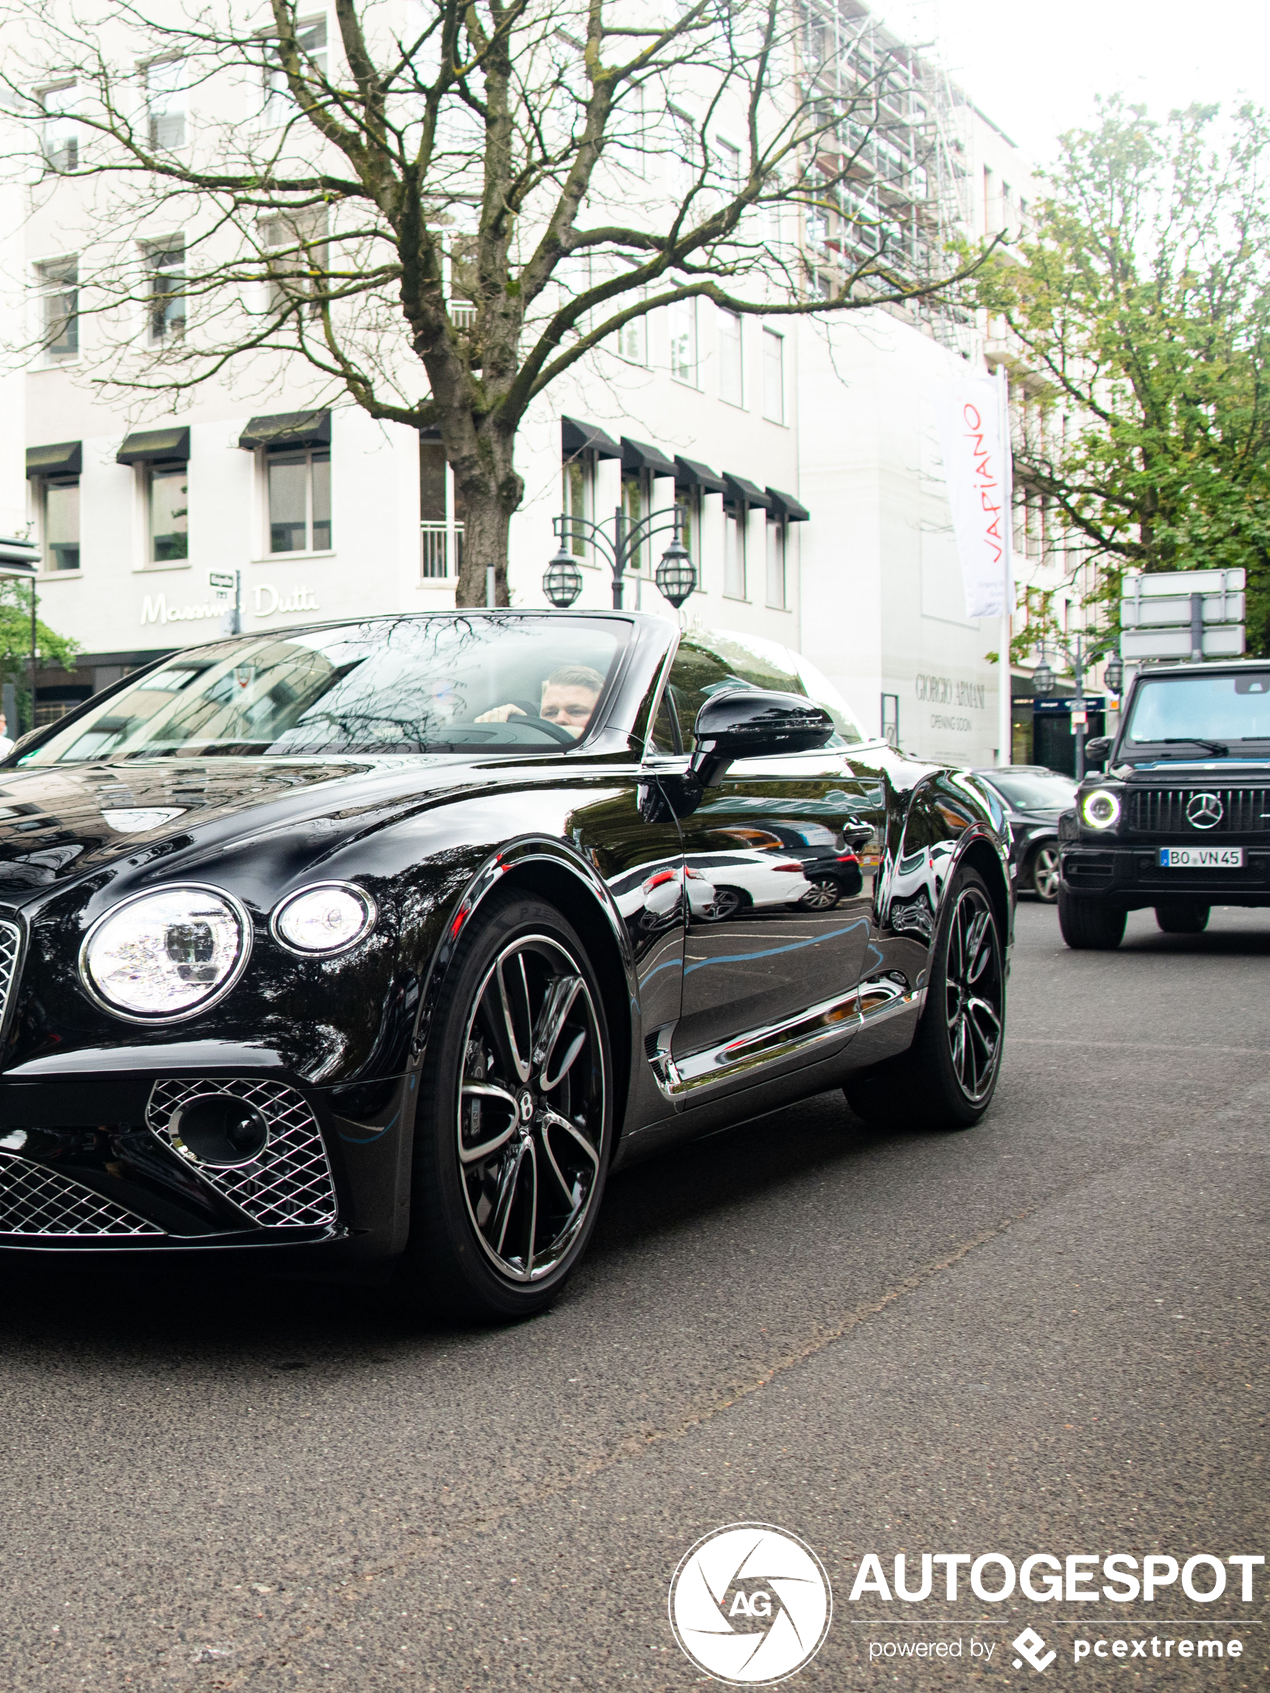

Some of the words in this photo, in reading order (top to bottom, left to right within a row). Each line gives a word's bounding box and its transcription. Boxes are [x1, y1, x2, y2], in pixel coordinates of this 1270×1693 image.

[252, 584, 320, 617] Dutti
[916, 674, 952, 705] GIORGIO
[955, 681, 985, 709] ARMANI
[931, 714, 955, 730] OPENING
[956, 717, 972, 732] SOON
[1171, 851, 1190, 865] BO
[1199, 851, 1219, 865] VN
[1220, 851, 1239, 865] 45
